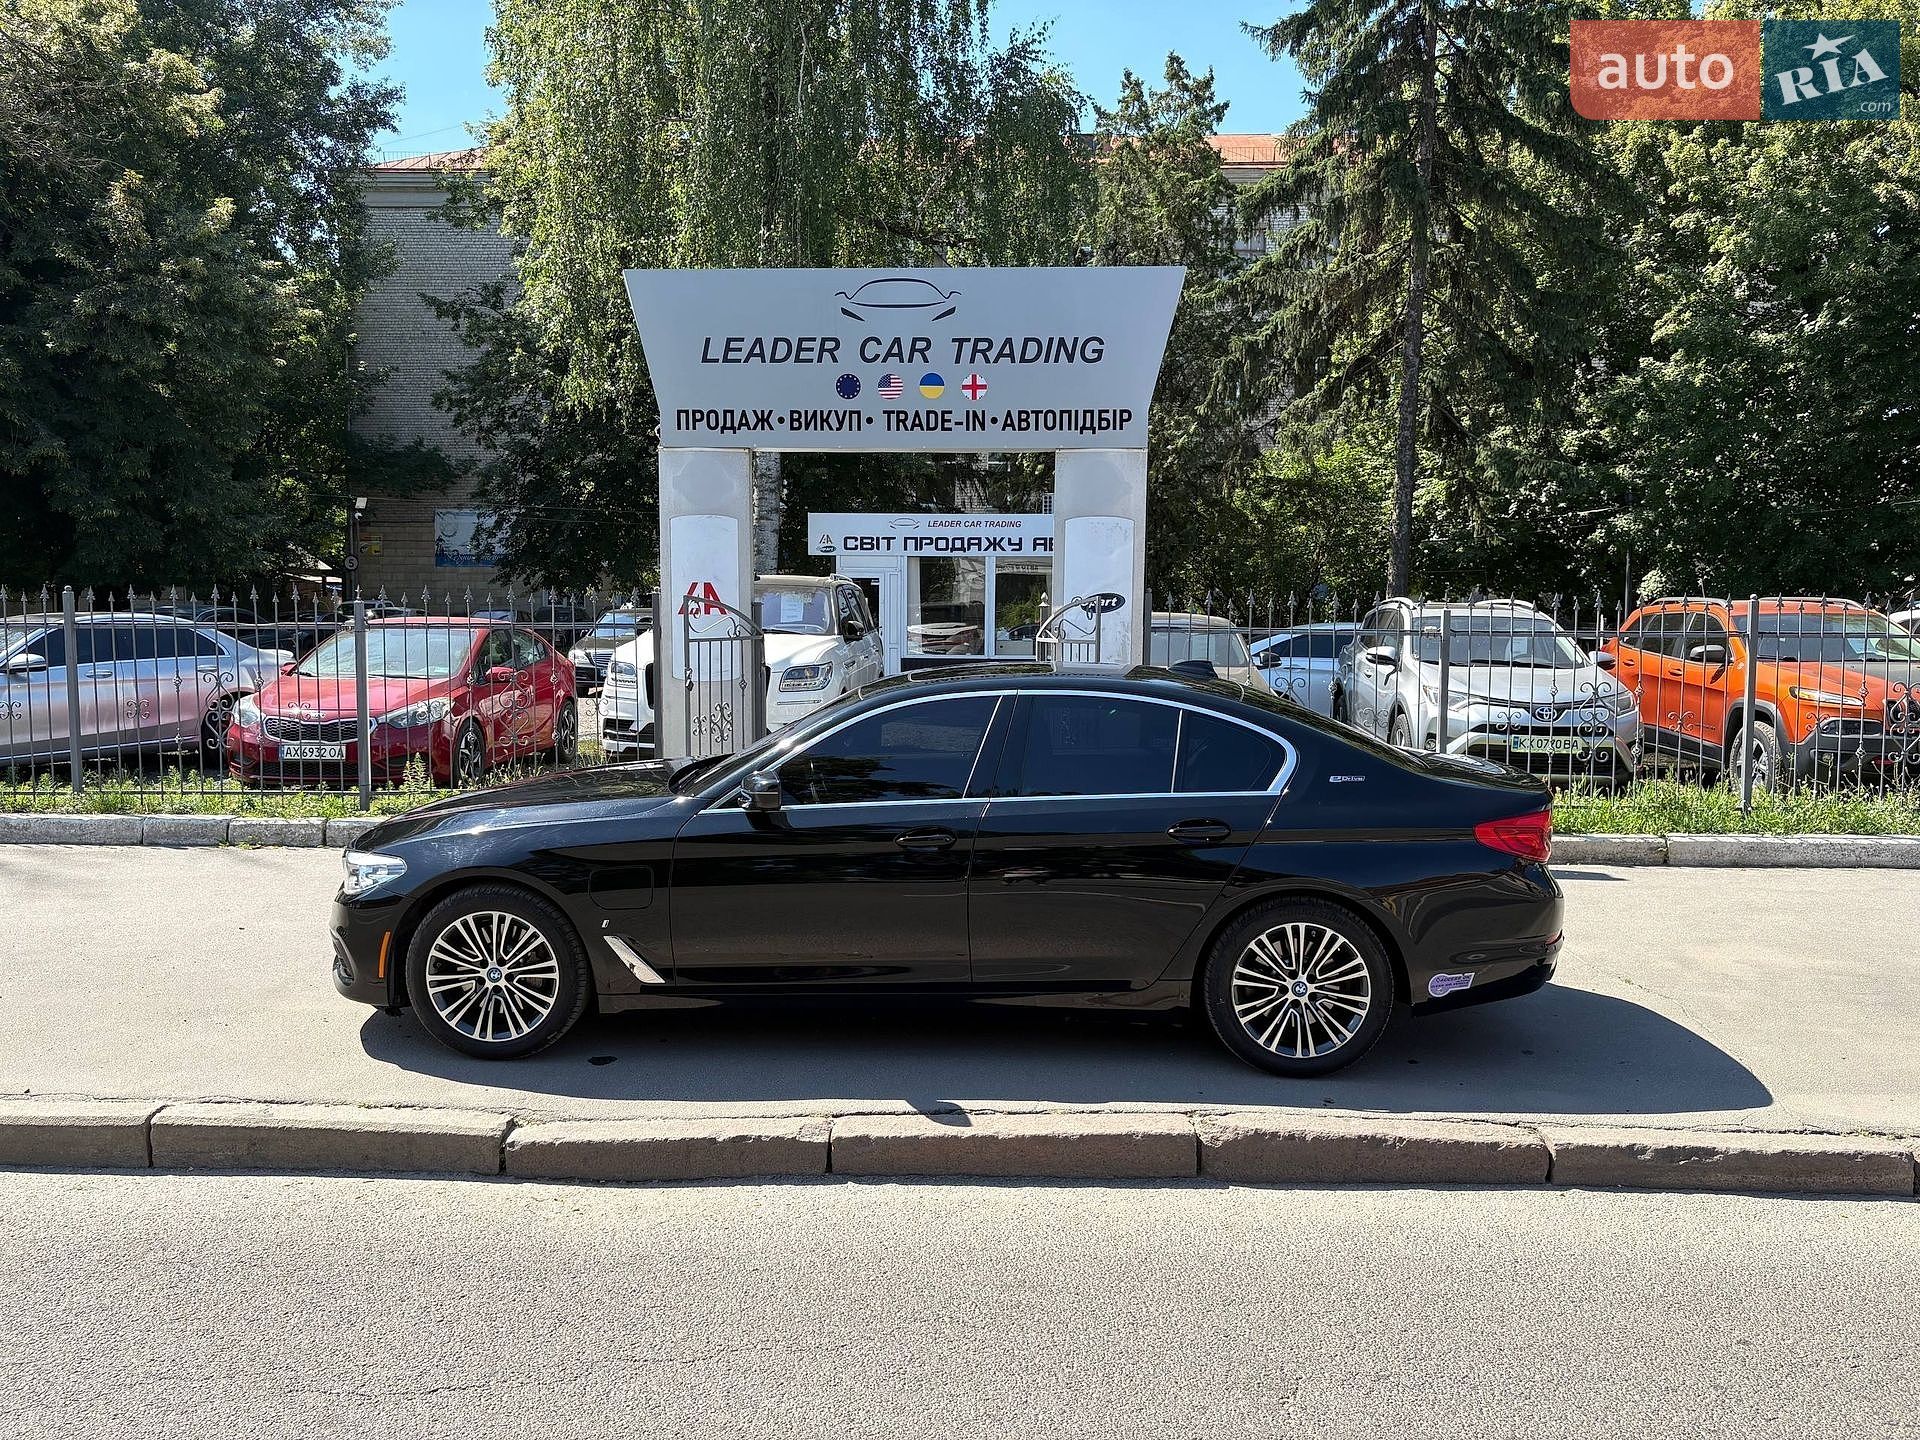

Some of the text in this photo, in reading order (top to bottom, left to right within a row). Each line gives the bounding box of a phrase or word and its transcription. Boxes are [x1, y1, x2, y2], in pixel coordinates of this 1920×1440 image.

[700, 336, 1105, 364] LEADER CAR TRADING
[676, 409, 1132, 435] ПРОДАЖ ВИКУП TRADE-IN АВТОПІДБІР
[928, 520, 1022, 528] LEADER CAR TRADING
[843, 536, 896, 551] СВІТ
[904, 536, 1023, 553] ПРОДАЖУ
